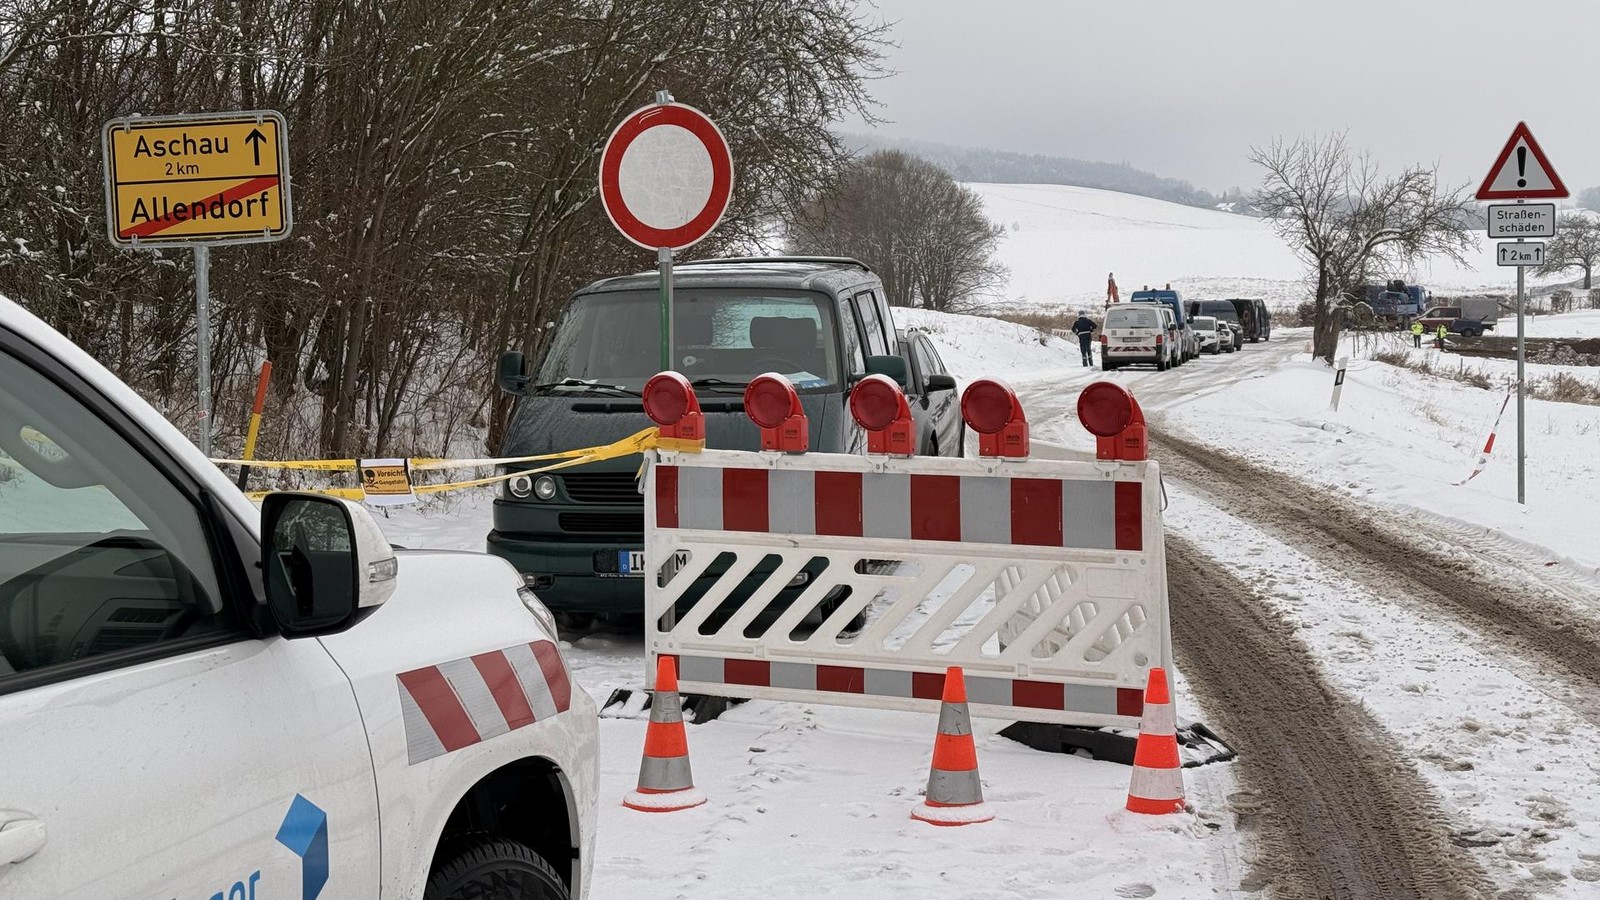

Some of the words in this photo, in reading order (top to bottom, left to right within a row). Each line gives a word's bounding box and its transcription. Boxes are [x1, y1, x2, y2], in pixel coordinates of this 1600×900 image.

[133, 133, 229, 158] Aschau
[165, 163, 174, 176] 2
[177, 162, 199, 175] km
[130, 191, 269, 223] Allendorf
[1497, 210, 1546, 220] Straßen-
[1499, 223, 1545, 232] schäden
[1511, 250, 1518, 260] 2
[1520, 252, 1531, 260] km
